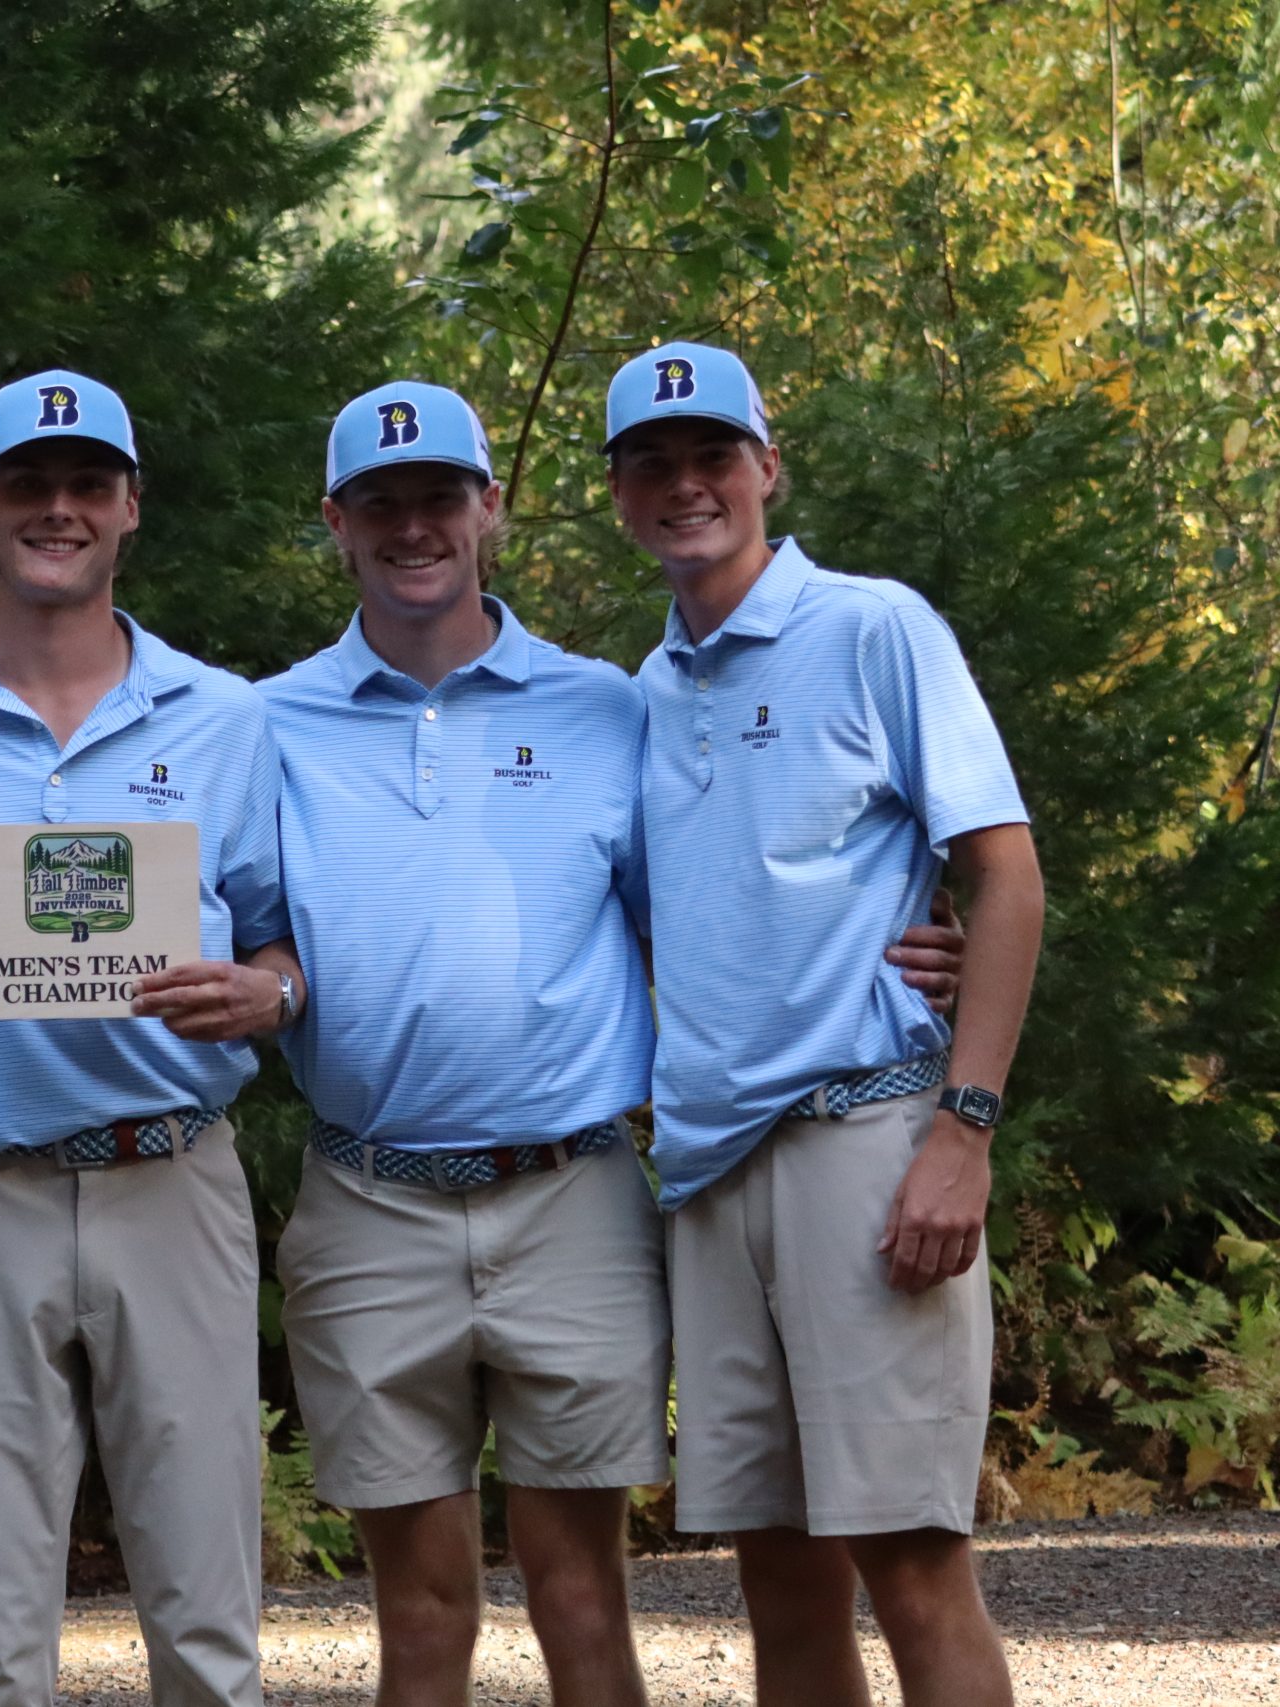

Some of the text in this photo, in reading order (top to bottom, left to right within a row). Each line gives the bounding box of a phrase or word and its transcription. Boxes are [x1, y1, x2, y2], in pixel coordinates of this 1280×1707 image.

[493, 768, 553, 780] BUSHNELL
[512, 780, 534, 788] GOLF
[128, 784, 186, 802] BUSHNELL
[147, 797, 168, 807] GOLF
[28, 862, 126, 894] Tall Timber
[35, 900, 124, 912] INVITATIONAL
[88, 955, 168, 975] TEAM
[3, 982, 137, 1003] CHAMPIO
